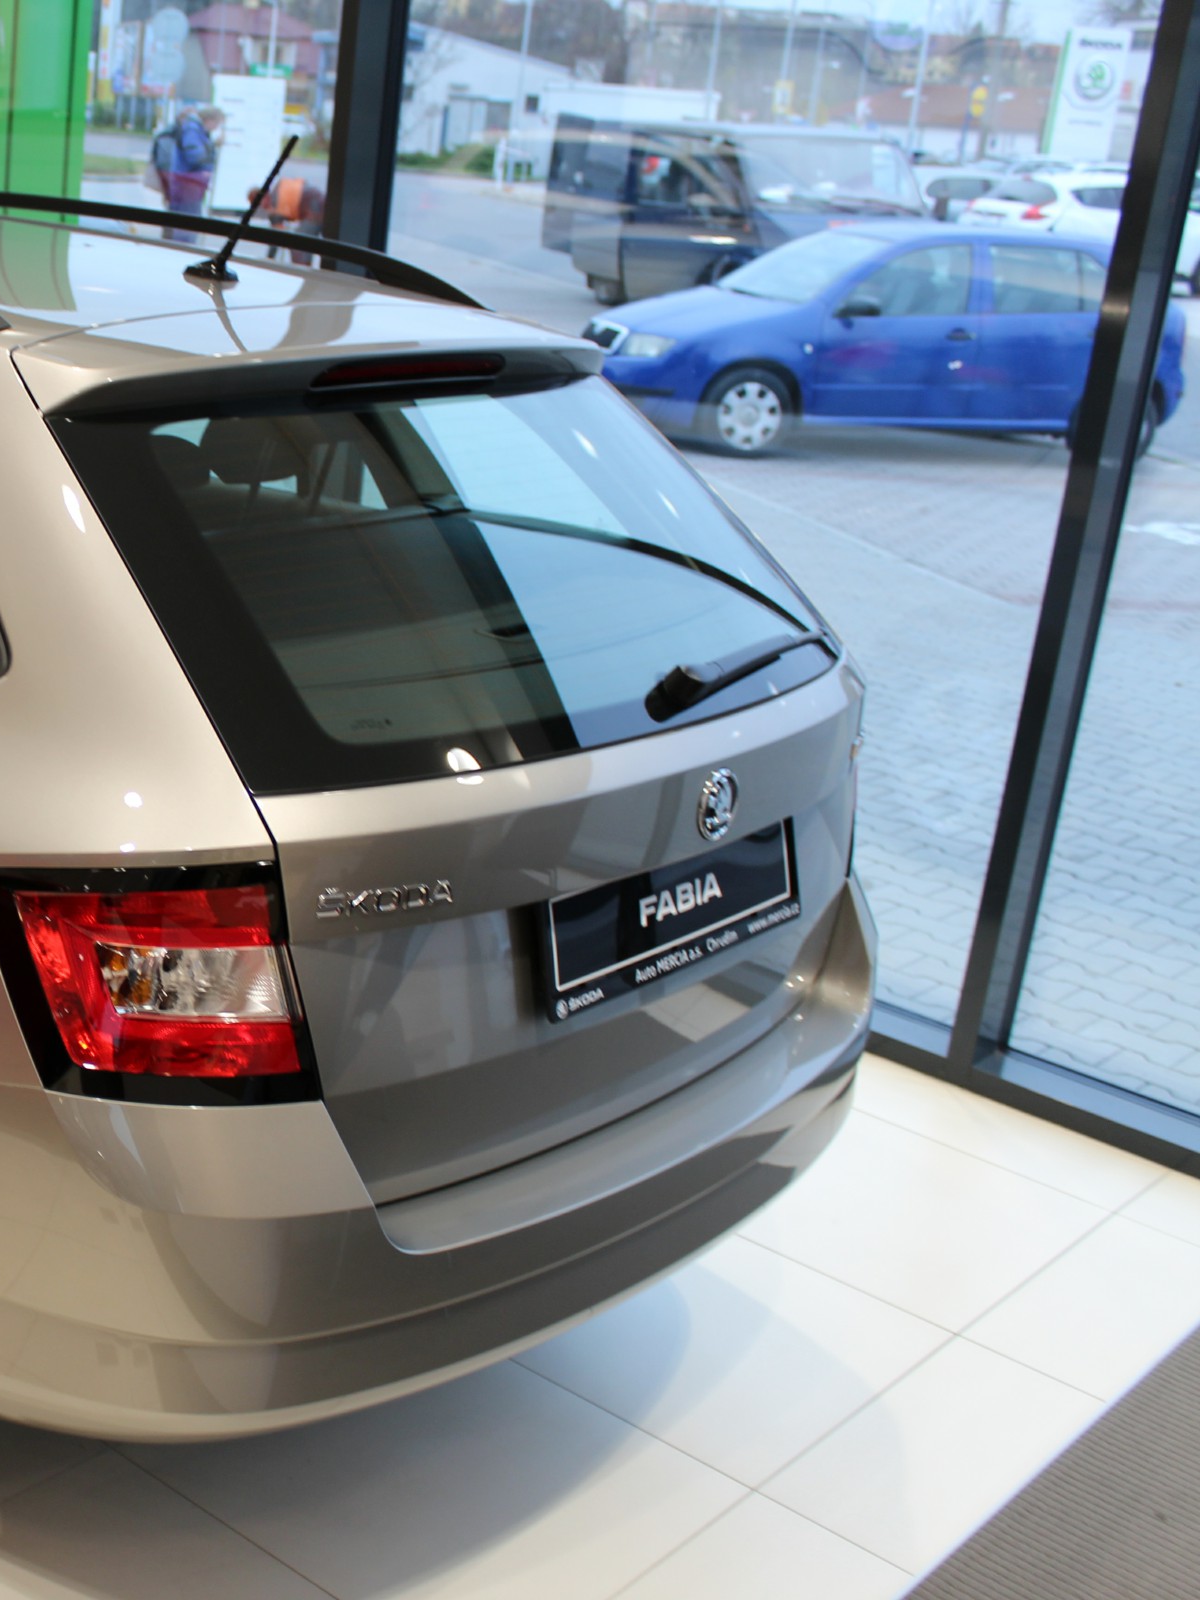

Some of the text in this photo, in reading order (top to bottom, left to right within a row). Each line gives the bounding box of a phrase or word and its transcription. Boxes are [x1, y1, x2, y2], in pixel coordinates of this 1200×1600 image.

[315, 878, 453, 919] ŠKODA
[639, 872, 723, 928] FABIA
[634, 965, 657, 984] Auto
[656, 948, 690, 974] MERCIA
[568, 986, 605, 1012] ŠKODA
